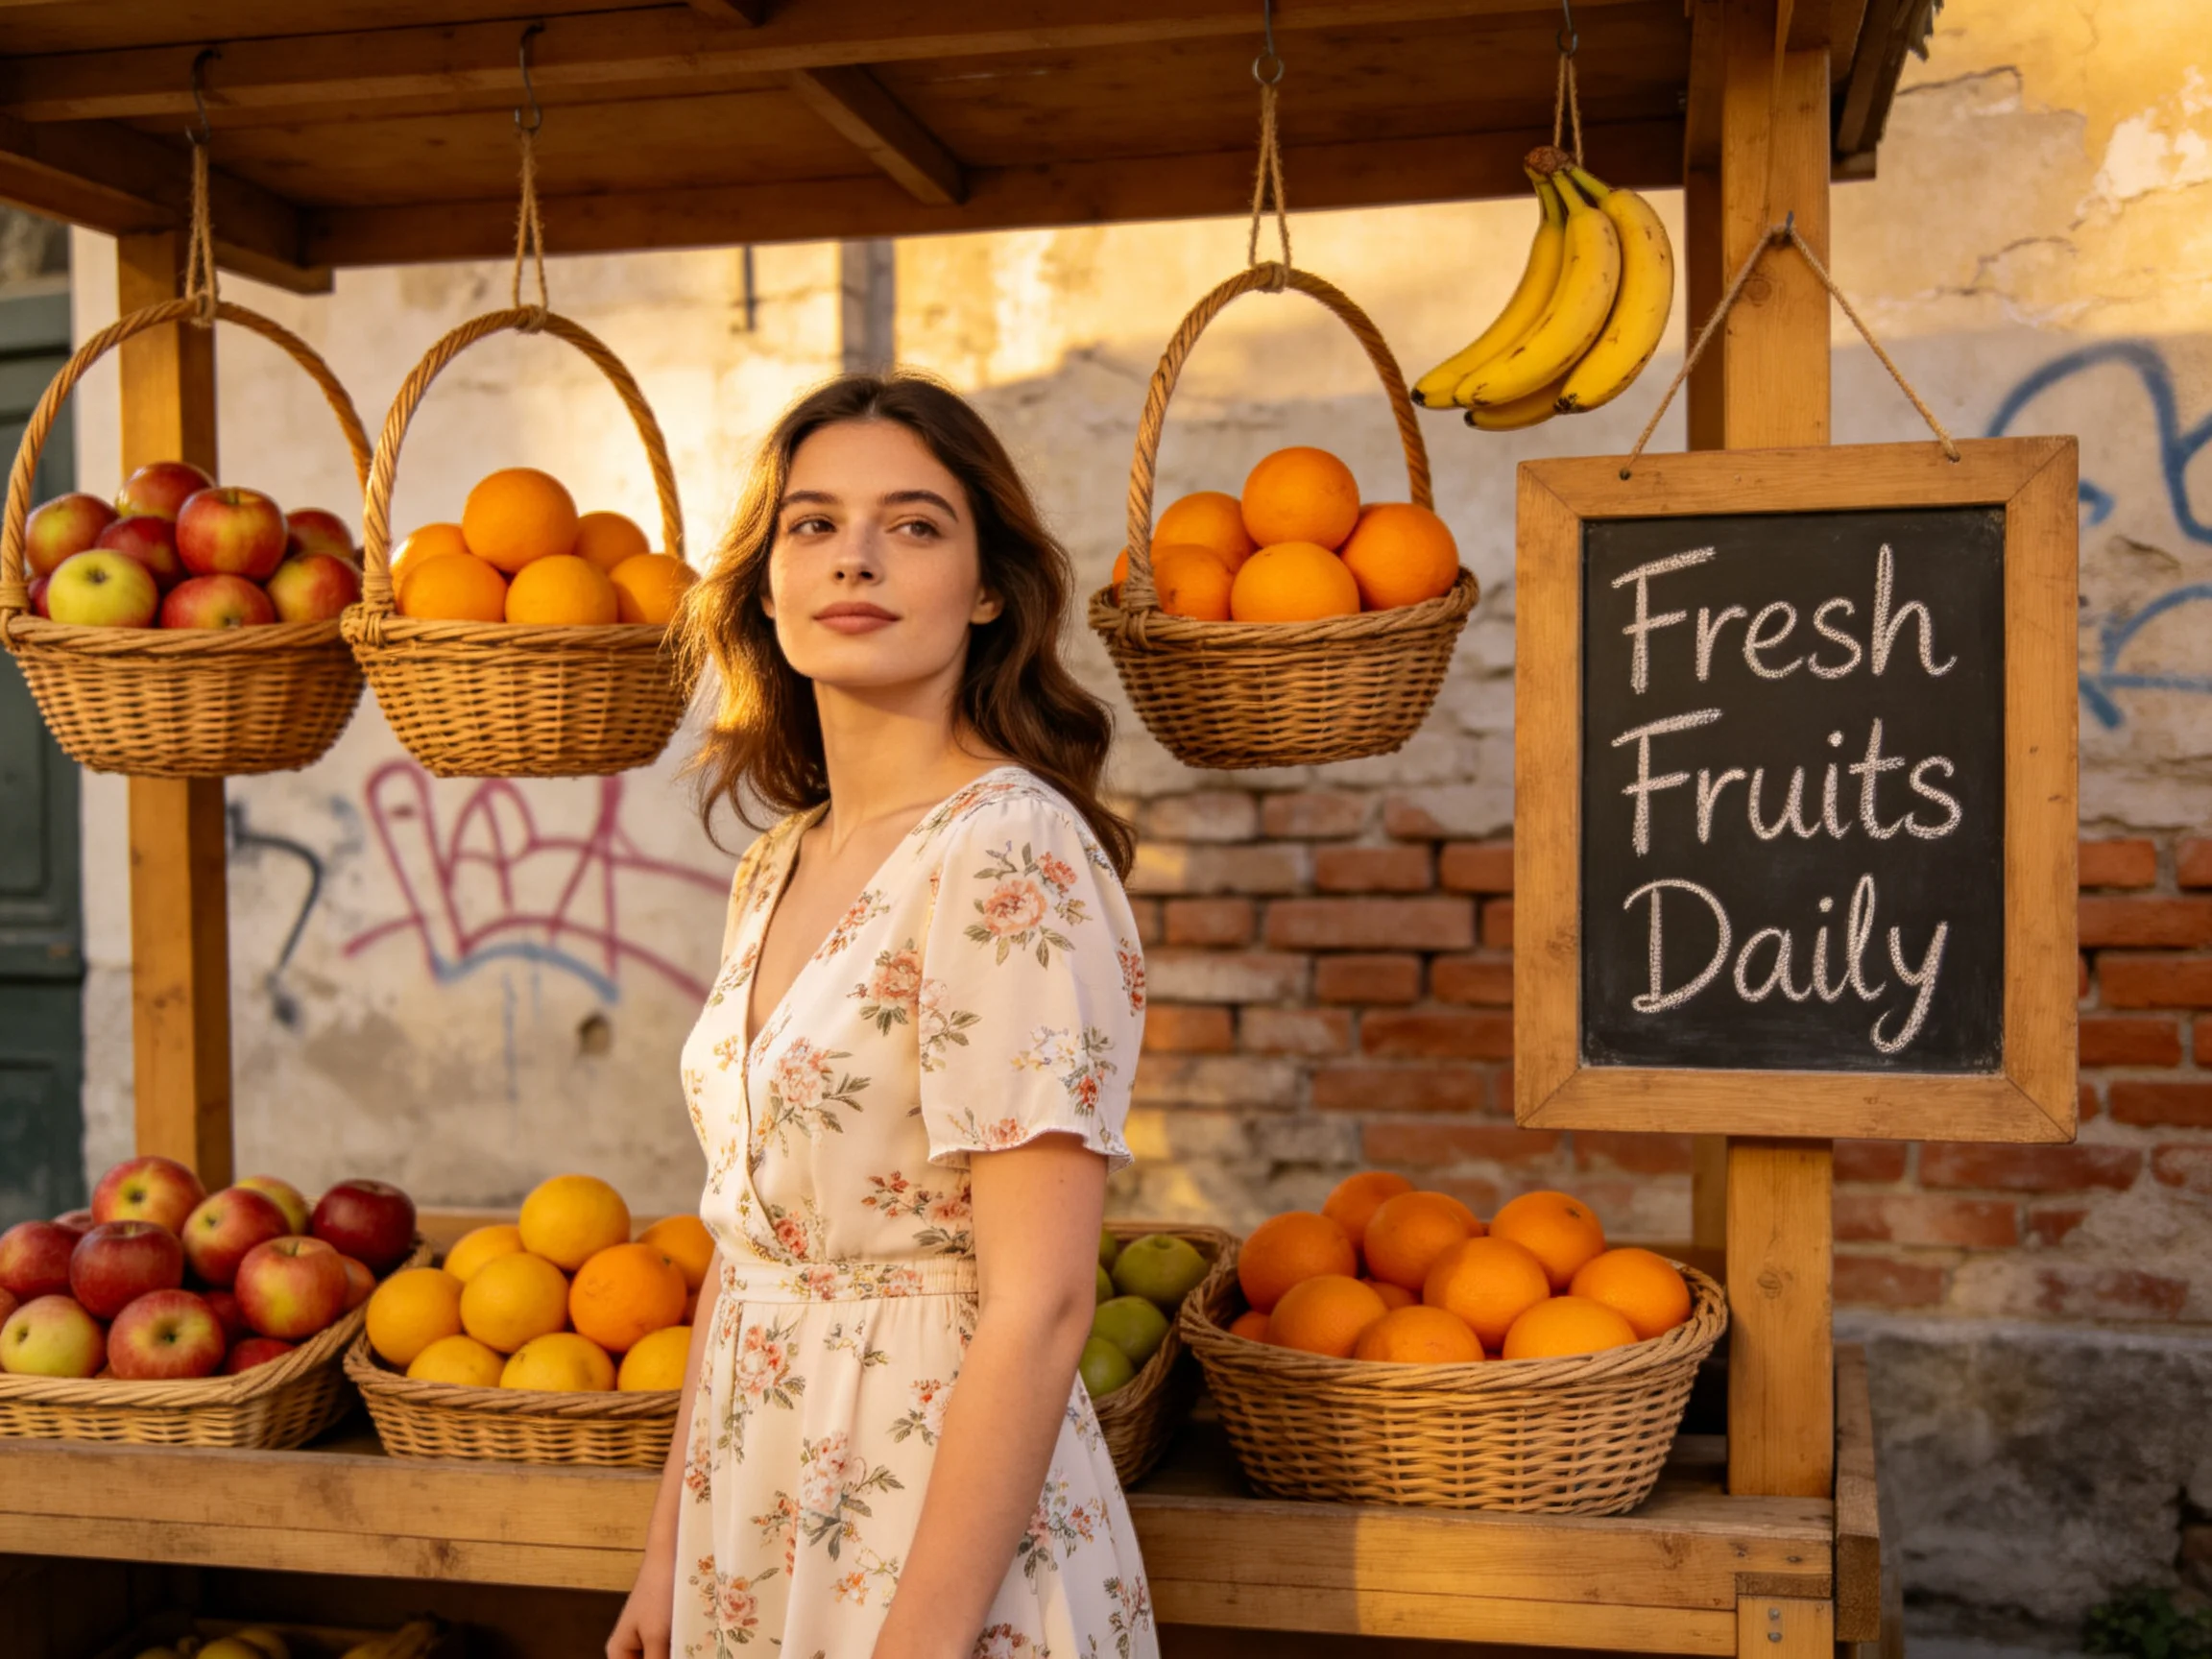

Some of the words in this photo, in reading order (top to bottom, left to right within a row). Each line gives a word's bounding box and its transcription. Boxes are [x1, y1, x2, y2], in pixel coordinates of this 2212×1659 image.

[1611, 543, 1958, 695] Fresh
[1611, 708, 1962, 857] Fruits
[1623, 875, 1948, 1053] Daily
